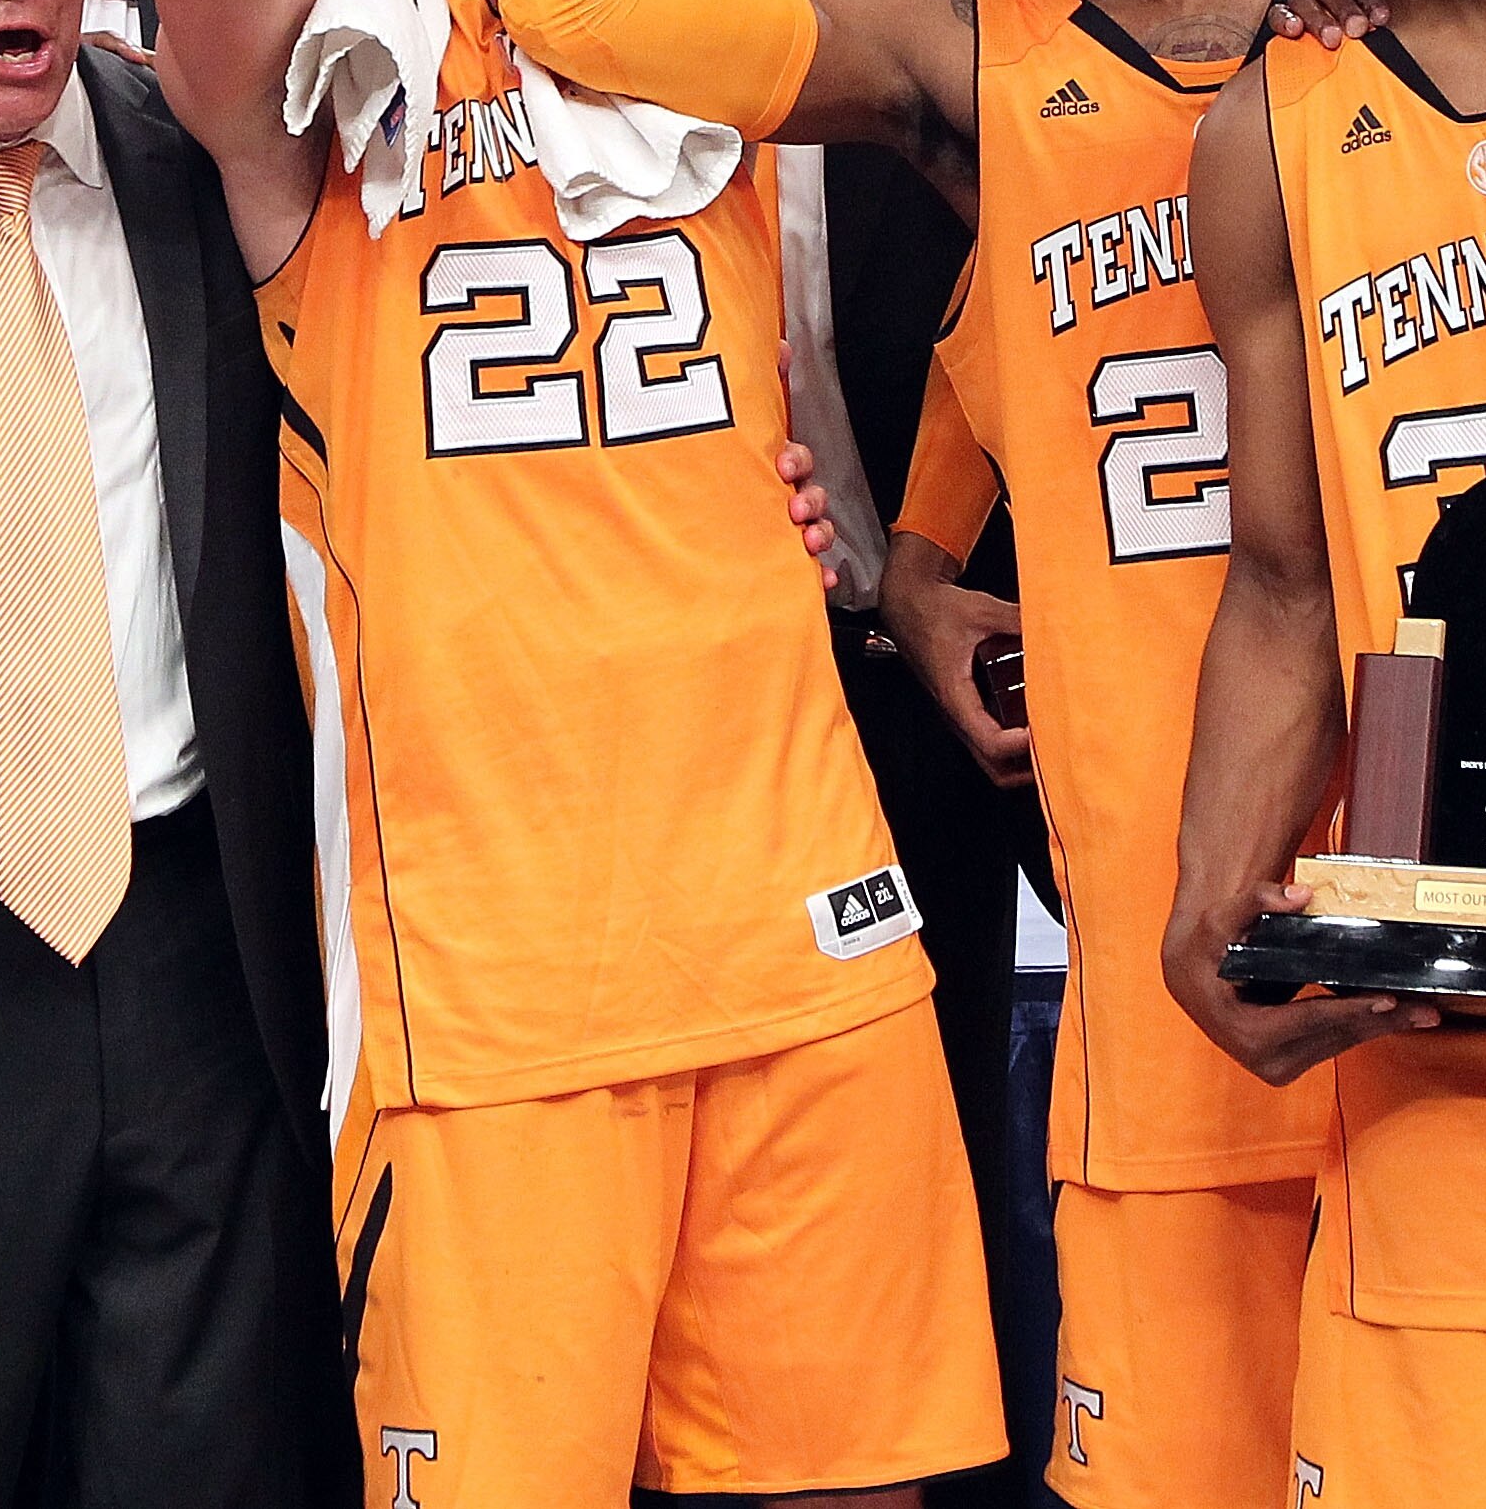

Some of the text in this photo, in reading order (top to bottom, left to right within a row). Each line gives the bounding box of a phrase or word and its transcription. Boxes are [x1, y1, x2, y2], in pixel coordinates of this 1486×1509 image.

[1040, 100, 1100, 119] adidas
[420, 228, 735, 460] 22
[1088, 344, 1232, 566] 2
[1423, 891, 1458, 904] MOST
[841, 908, 871, 927] adidas
